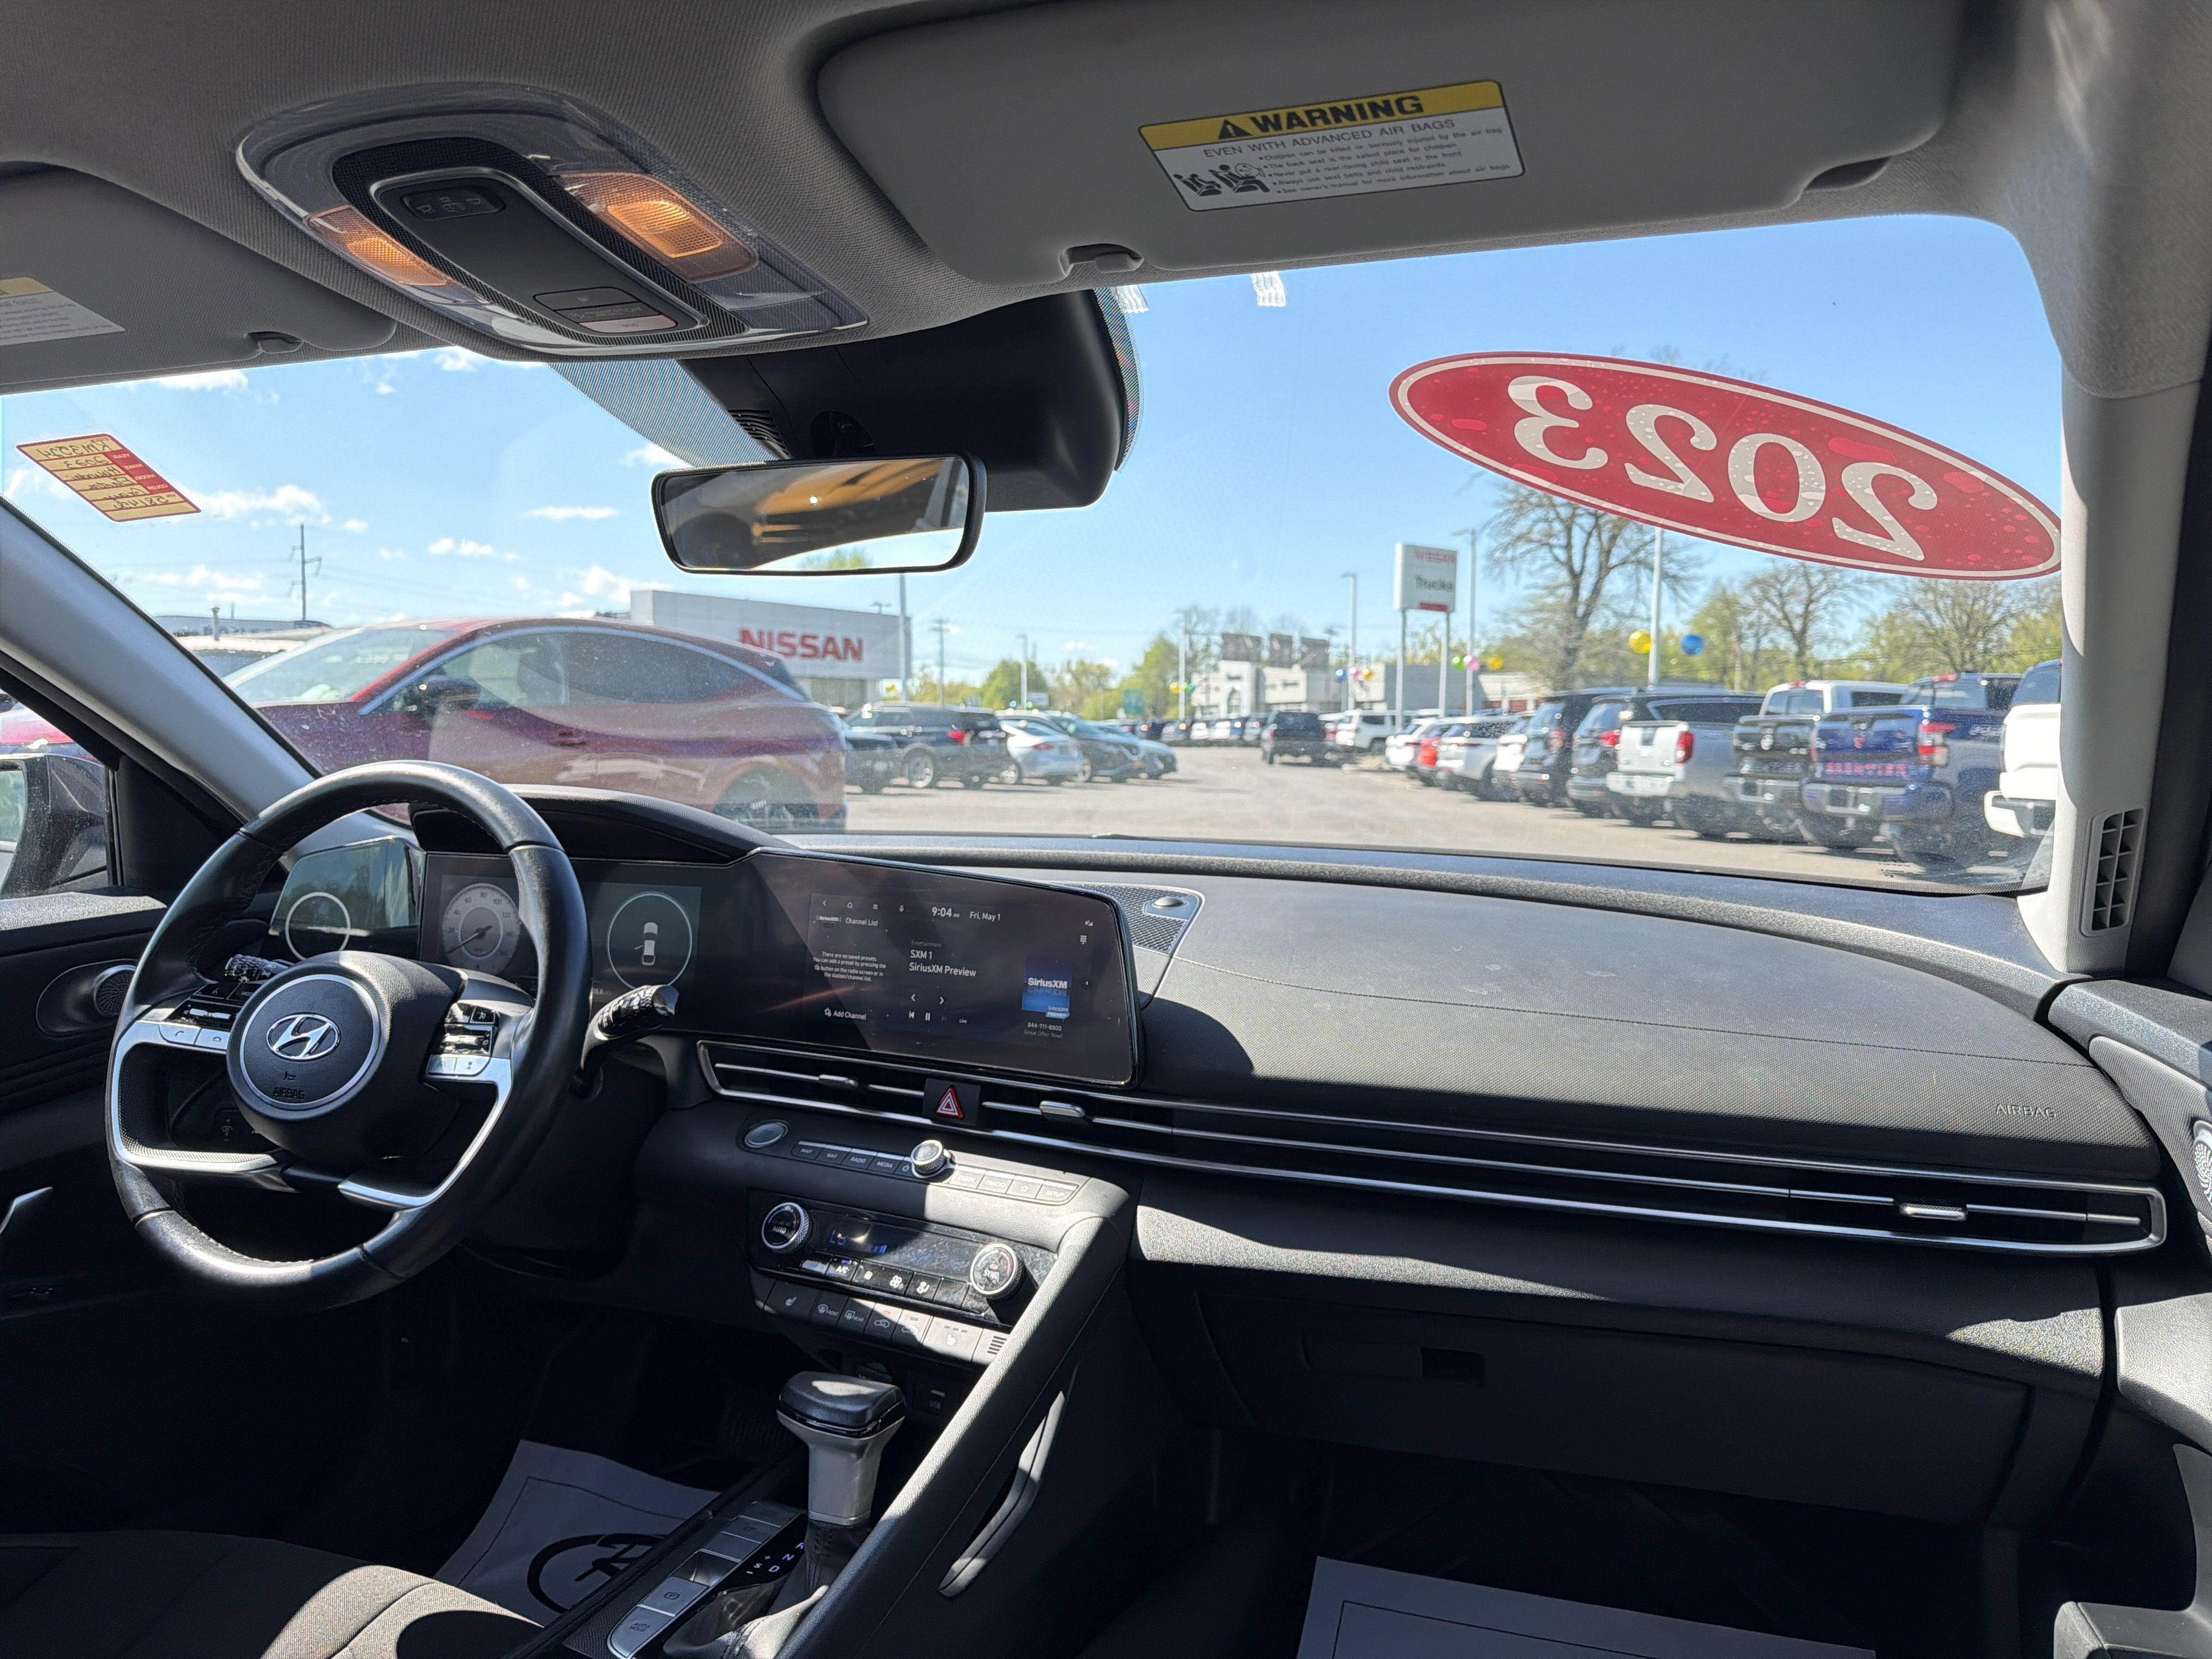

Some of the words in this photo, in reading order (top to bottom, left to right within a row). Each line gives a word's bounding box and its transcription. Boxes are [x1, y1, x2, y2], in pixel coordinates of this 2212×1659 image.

[1249, 95, 1425, 134] WARNING
[1204, 146, 1242, 157] EVEN
[1248, 141, 1285, 152] WITH
[1293, 129, 1372, 148] ADVANCED
[1379, 126, 1404, 137] AIR
[1411, 119, 1455, 132] BAGS
[1330, 145, 1351, 153] killed
[1368, 140, 1403, 149] seriously
[1407, 136, 1435, 144] injured
[1384, 149, 1405, 157] place
[1424, 143, 1456, 151] children
[1407, 162, 1446, 171] restraints
[1331, 180, 1359, 189] manual
[1400, 172, 1444, 181] information
[739, 629, 865, 662] NISSAN
[932, 906, 952, 918] 9:04
[969, 911, 981, 920] Fri,
[982, 912, 996, 922] May
[845, 917, 867, 926] Channel
[910, 949, 927, 958] SXM
[928, 951, 933, 960] 1
[909, 962, 943, 973] SiriusXM
[944, 965, 977, 977] Preview
[1028, 977, 1068, 989] SiriusXM
[844, 1011, 867, 1020] Channel
[1027, 1022, 1062, 1031] 844-711-8800
[273, 1087, 306, 1099] AIRBAG
[1995, 1103, 2057, 1119] AIRBAG
[772, 1226, 787, 1234] AUTO
[826, 1308, 839, 1316] FRONT
[781, 1553, 795, 1561] N
